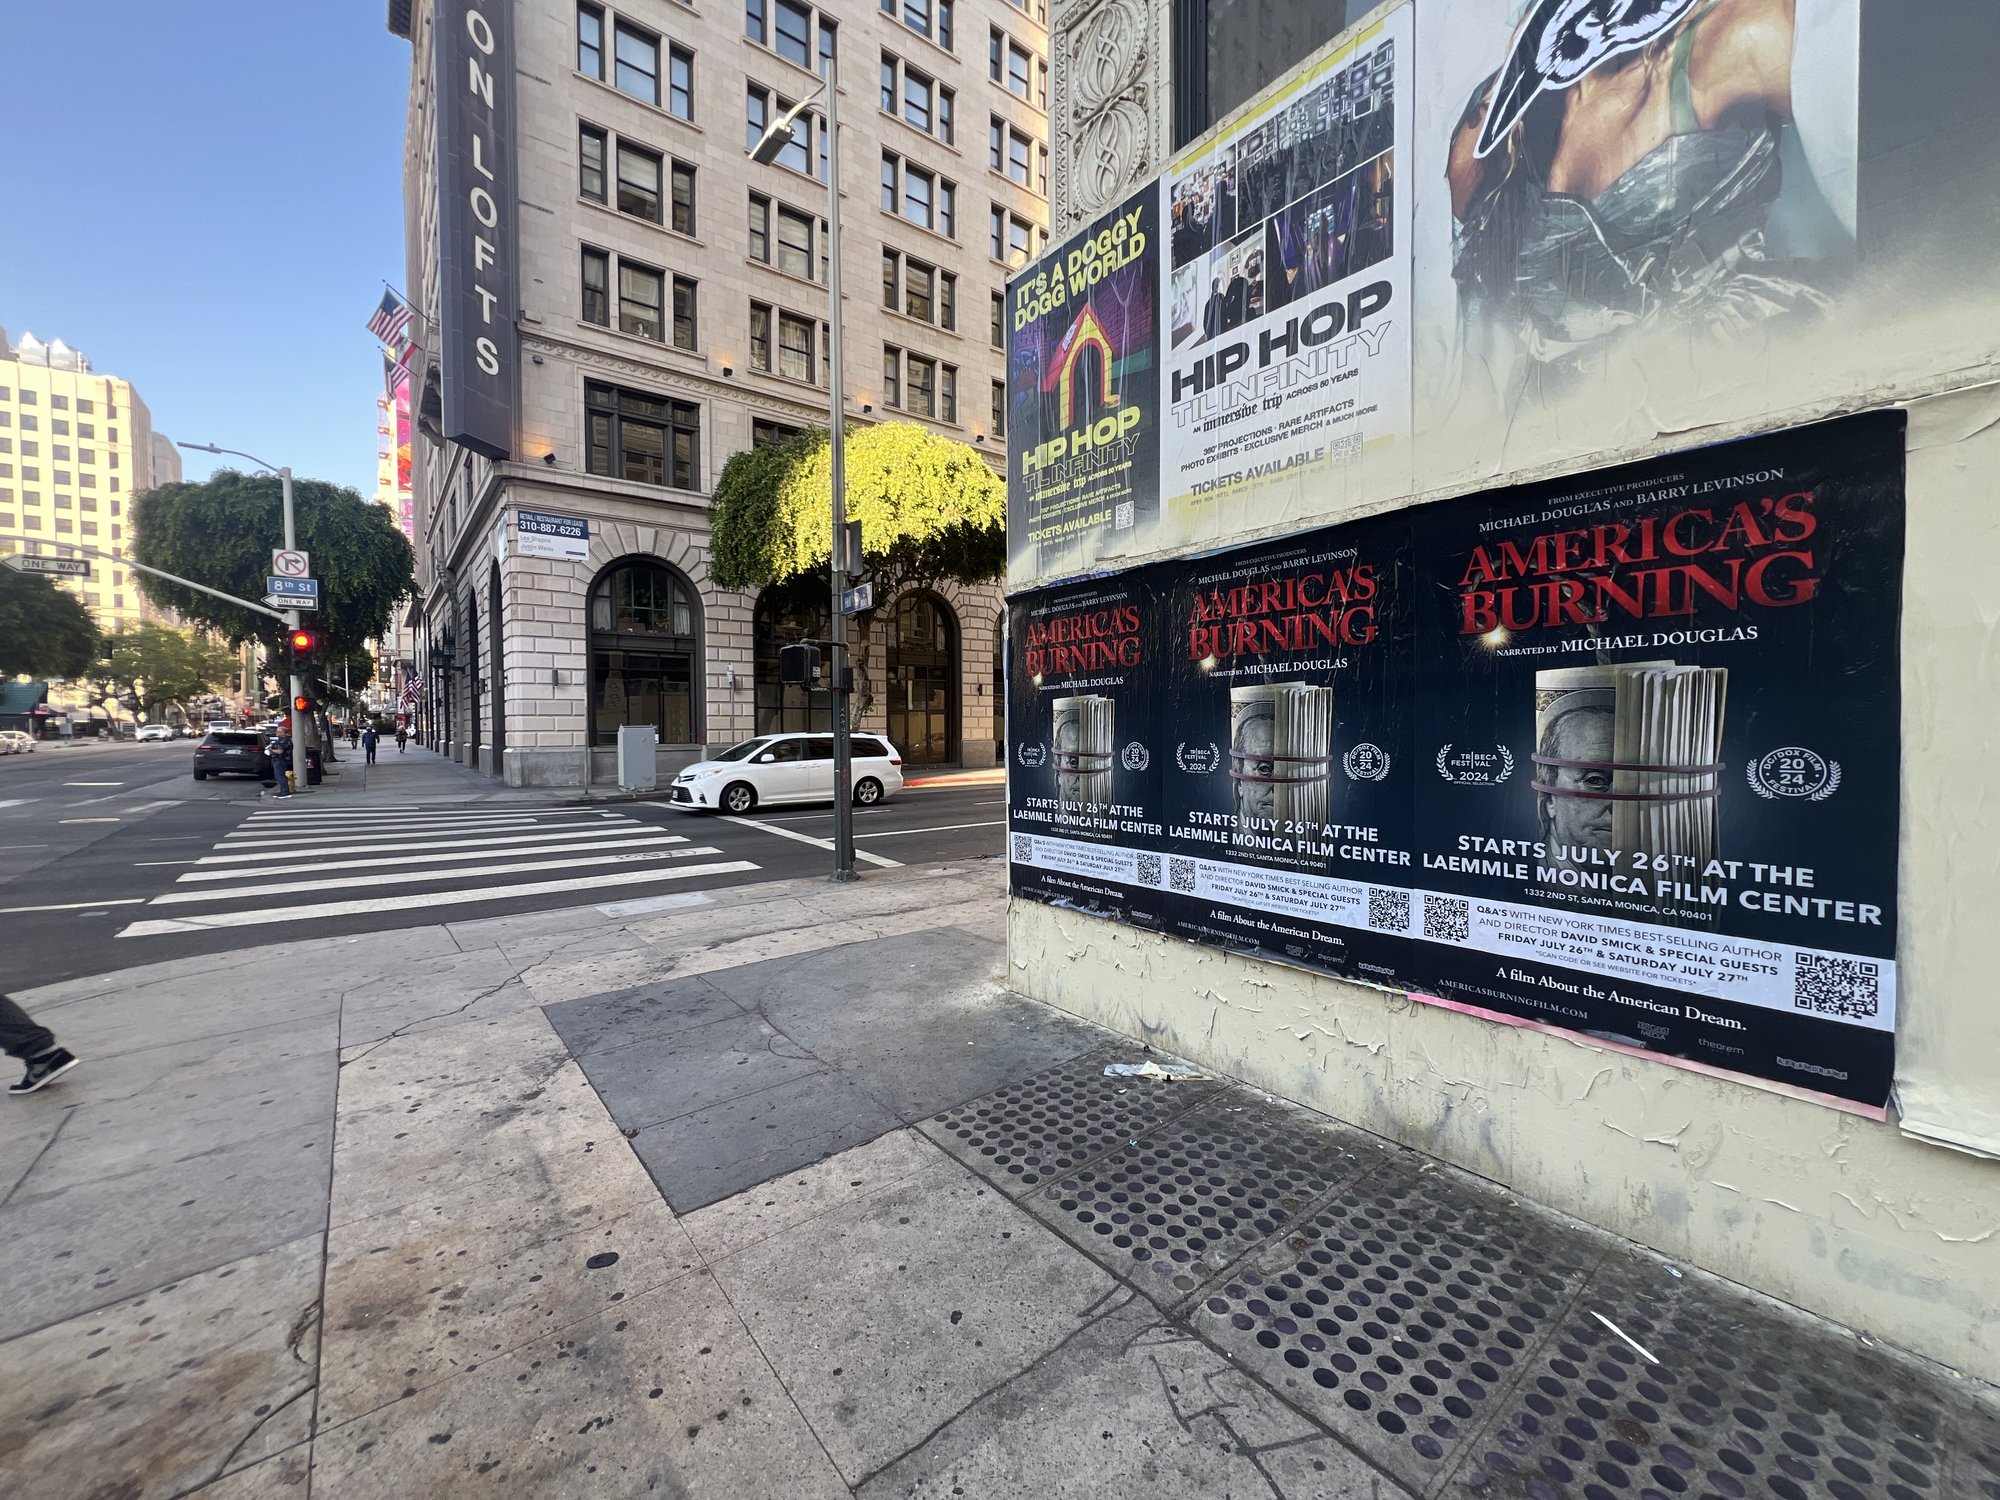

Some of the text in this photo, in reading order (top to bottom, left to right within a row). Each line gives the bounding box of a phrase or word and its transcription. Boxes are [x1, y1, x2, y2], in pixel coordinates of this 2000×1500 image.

[467, 0, 499, 376] ON LOFTS
[1018, 205, 1142, 309] IT'S A DOGGY
[1016, 233, 1145, 331] DOGG WORLD
[1172, 280, 1393, 404] HIP HOP
[1172, 320, 1392, 428] TIL INFINITY
[1193, 426, 1200, 434] AN
[1203, 403, 1258, 432] immersive
[1263, 393, 1283, 411] trip
[1286, 383, 1318, 400] ACROSS
[1330, 369, 1359, 384] YEARS
[1023, 406, 1140, 475] HIP HOP
[1181, 404, 1378, 472] PHOTO EXHIBITS EXCLUSIVE MERCH MUCH MORE
[1218, 399, 1354, 451] PROJECTIONS RARE ARTIFACTS
[1023, 433, 1140, 492] TIL INFINITY
[1191, 471, 1242, 496] TICKETS
[1246, 448, 1324, 481] AVAILABLE
[1479, 468, 1785, 532] MICHAEL DOUGLAS AND BARRY LEVINSON
[1548, 473, 1684, 505] FROM EXECUTIVE PRODUCERS
[520, 521, 581, 536] 310-887-6226
[537, 516, 562, 524] RESTAURANT
[1028, 526, 1062, 542] TICKETS
[1063, 510, 1111, 533] AVAILABLE
[1458, 492, 1817, 586] AMERICA'S
[22, 560, 80, 571] ONE WAY
[274, 581, 311, 591] 8th St
[1199, 548, 1358, 584] MICHAEL DOUGLAS BARRY LEVINSON
[1188, 565, 1376, 624] AMERICA'S
[1459, 551, 1821, 634] BURNING
[1024, 605, 1140, 648] AMERICA'S
[1188, 607, 1378, 660] BURNING
[1496, 626, 1758, 656] NARRATED BY MICHAEL DOUGLAS
[1025, 636, 1141, 677] BURNING
[1244, 658, 1347, 675] MICHAEL DOUGLAS
[1460, 772, 1489, 781] 2024
[1763, 750, 1822, 771] DC/DOX FILM
[1780, 758, 1804, 769] 20
[1780, 774, 1804, 784] 24
[1027, 797, 1143, 818] STARTS JULY 26TH AT THE
[1768, 780, 1817, 793] FESTIVAL
[1055, 814, 1092, 828] MONICA
[1094, 818, 1117, 830] FILM
[1121, 821, 1162, 836] CENTER
[1169, 825, 1411, 867] LAEMMLE MONICA FILM CENTER
[1188, 811, 1379, 842] STARTS JULY 26TH AT THE
[1458, 835, 1814, 888] STARTS JULY 26TH AT THE
[1423, 853, 1883, 926] LAEMMLE MONICA FILM CENTER
[1524, 888, 1545, 898] 1332
[1546, 891, 1566, 900] 2ND
[1581, 896, 1613, 907] SANTA
[1615, 901, 1660, 914] MONICA,
[1662, 907, 1678, 917] CA
[1680, 909, 1713, 921] 90401
[1477, 906, 1782, 962] Q&A'S WITH NEW YORK TIMES BEST-SELLING AUTHOR
[1479, 918, 1778, 976] AND DIRECTOR DAVID SMICK & SPECIAL GUESTS
[1498, 933, 1748, 982] FRIDAY JULY 26TH & SATURDAY JULY 27TH
[1558, 955, 1578, 964] CODE
[1592, 961, 1606, 969] SEE
[1608, 964, 1640, 976] WEBSITE
[1642, 971, 1658, 980] FOR
[1438, 978, 1588, 1020] AMERICASBURNINGFILM.COM
[1496, 966, 1747, 1031] A film About the American Dream.
[1640, 1030, 1666, 1040] MEDIA
[1699, 1038, 1744, 1055] theorem
